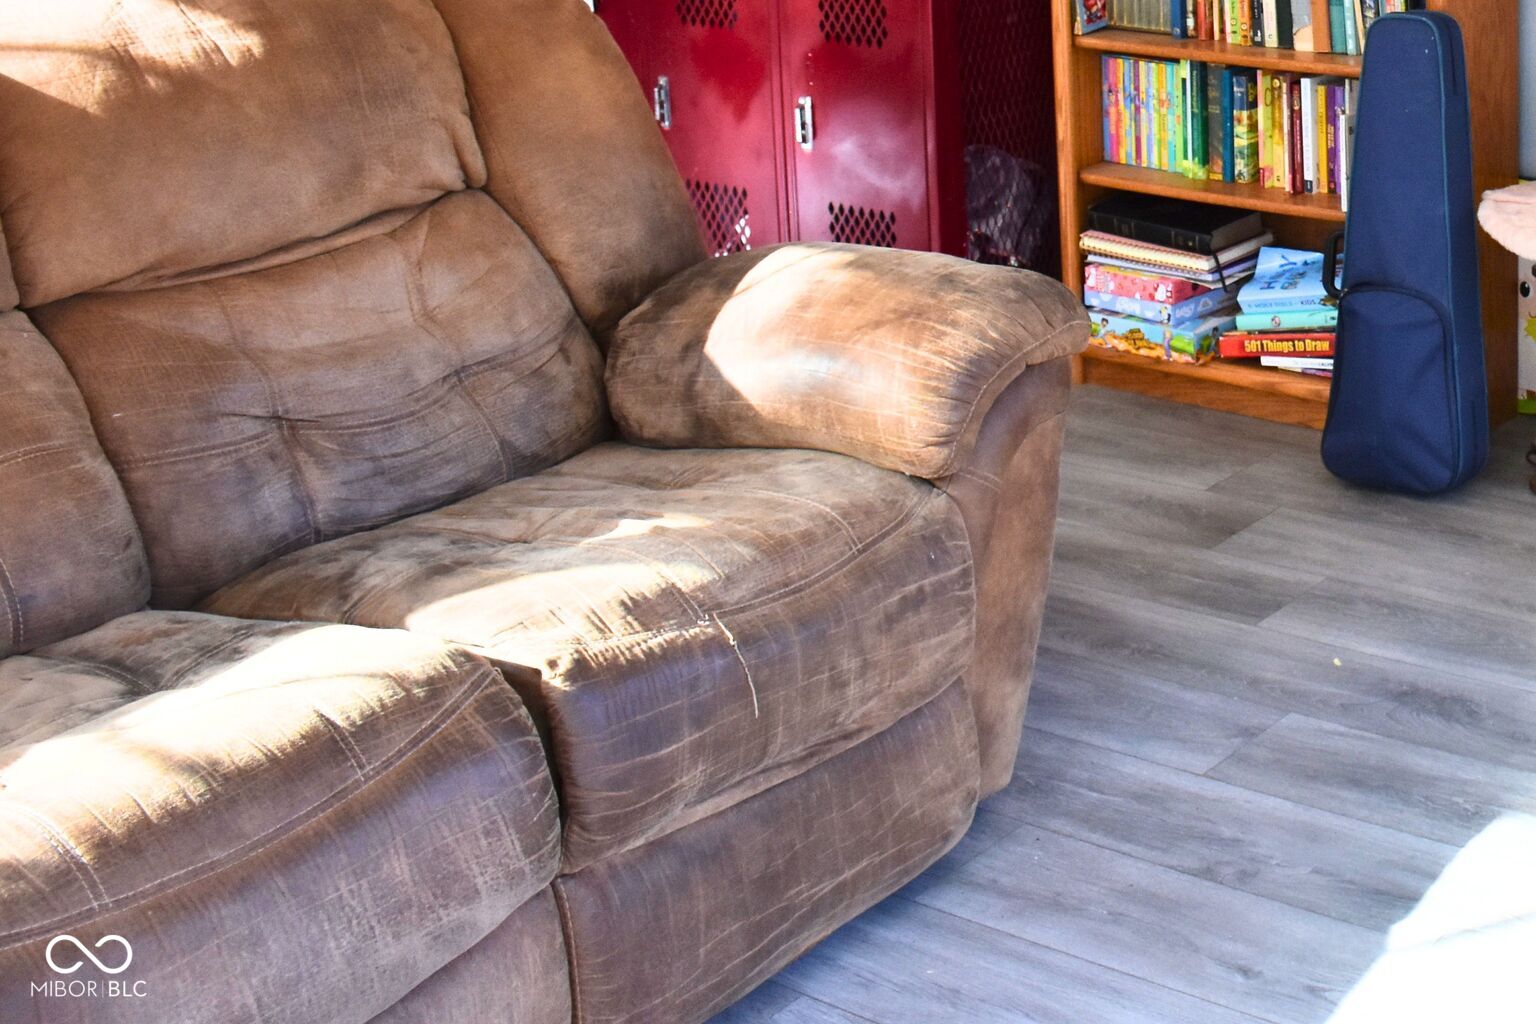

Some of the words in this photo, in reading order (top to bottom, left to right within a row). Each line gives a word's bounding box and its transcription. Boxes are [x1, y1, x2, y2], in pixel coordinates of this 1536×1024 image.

[1244, 339, 1261, 352] 501
[1262, 339, 1294, 353] Things
[1294, 340, 1304, 352] to
[1305, 339, 1330, 351] Draw
